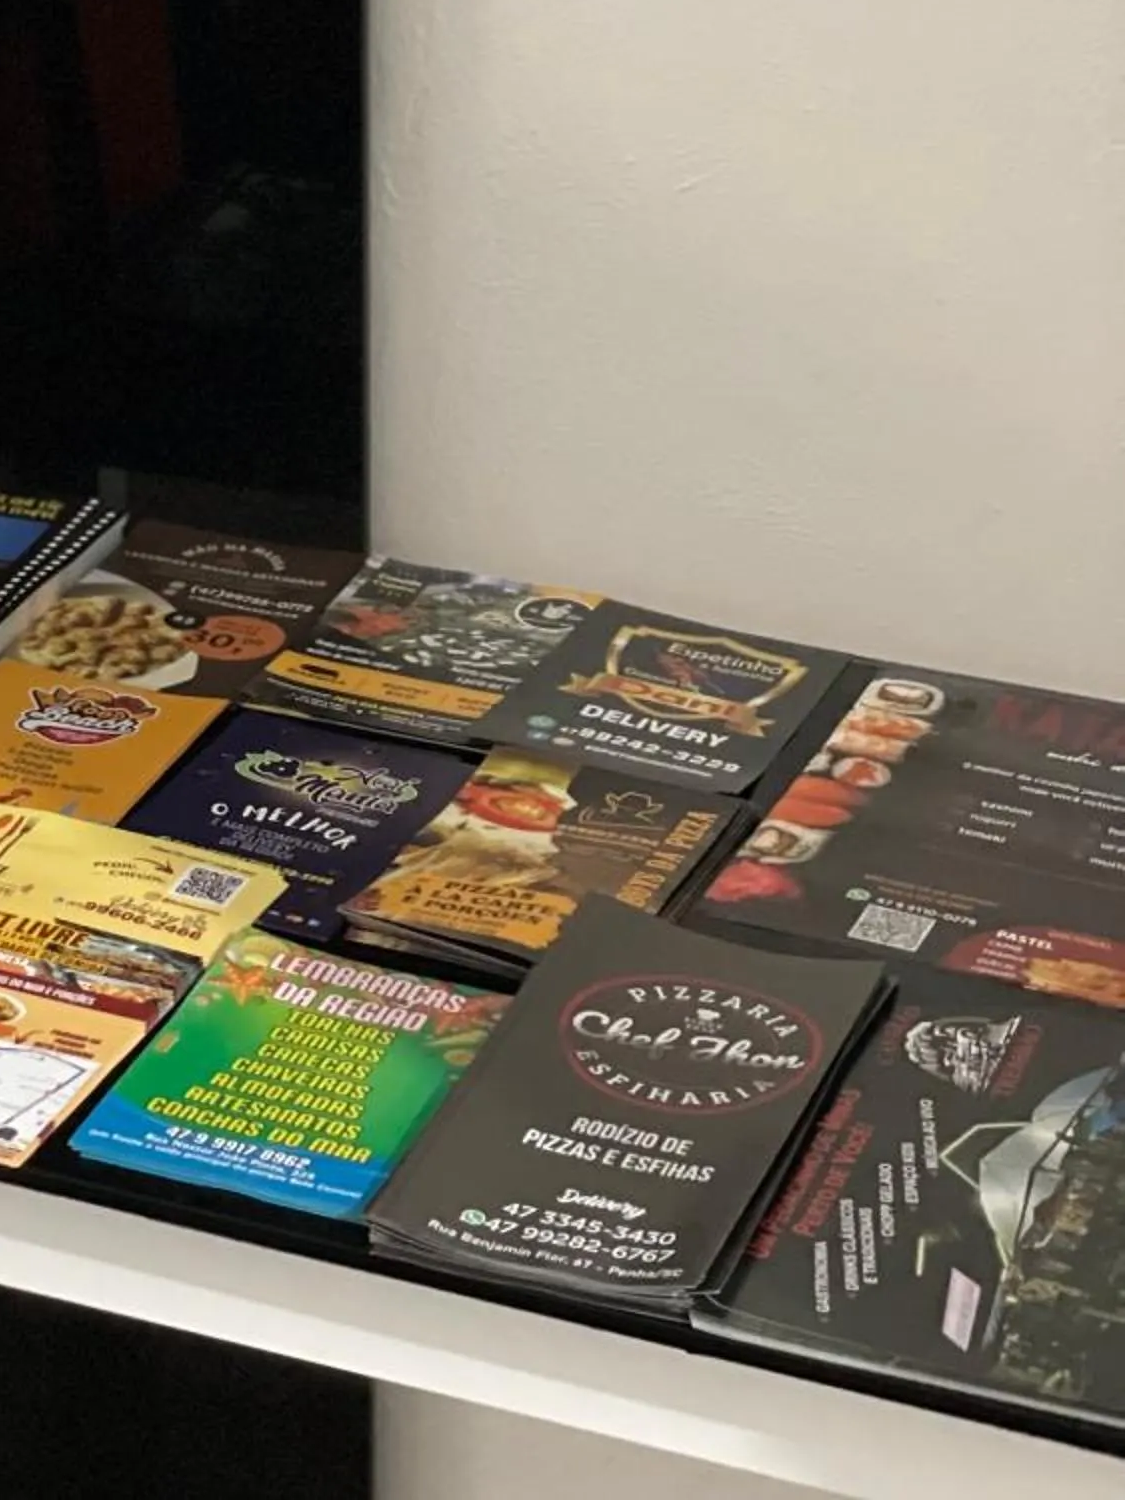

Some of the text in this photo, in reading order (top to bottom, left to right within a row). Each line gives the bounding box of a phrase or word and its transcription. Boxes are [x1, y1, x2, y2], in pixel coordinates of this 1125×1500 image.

[580, 704, 729, 747] DELIVERY
[210, 802, 229, 816] O
[241, 803, 358, 850] MELHOR
[444, 880, 538, 901] PIZZAS
[469, 895, 558, 916] CARTE
[16, 917, 89, 949] LIVRE
[996, 929, 1053, 950] PASTEL
[270, 953, 467, 1013] LEMBRANÇAS
[273, 981, 320, 1007] DA
[289, 1008, 396, 1045] TOALHAS
[628, 985, 800, 1038] PIZZARIA
[270, 1027, 386, 1063] CAMISAS
[573, 1010, 681, 1060] Chef
[232, 1059, 371, 1100] CHAVEIROS
[258, 1043, 371, 1080] CANECAS
[576, 1049, 775, 1105] ESFIHARIA
[185, 1086, 362, 1140] ARTESANATOS
[210, 1072, 364, 1120] ALMOFADAS
[146, 1097, 372, 1164] CONCHAS DO MAR
[166, 1126, 186, 1139] 47
[194, 1133, 208, 1146] 9
[211, 1137, 256, 1157] 9917
[571, 1116, 694, 1156] RODÍZIO DE
[522, 1128, 716, 1182] PIZZAS E ESFIHAS
[878, 1163, 896, 1237] CHOPP GELADO
[902, 1164, 920, 1204] ESPAÇO
[427, 1219, 457, 1237] Rua
[459, 1230, 532, 1259] Benjamin
[484, 1218, 676, 1263] 47 99282-6767
[503, 1203, 677, 1246] 47 3345-3430
